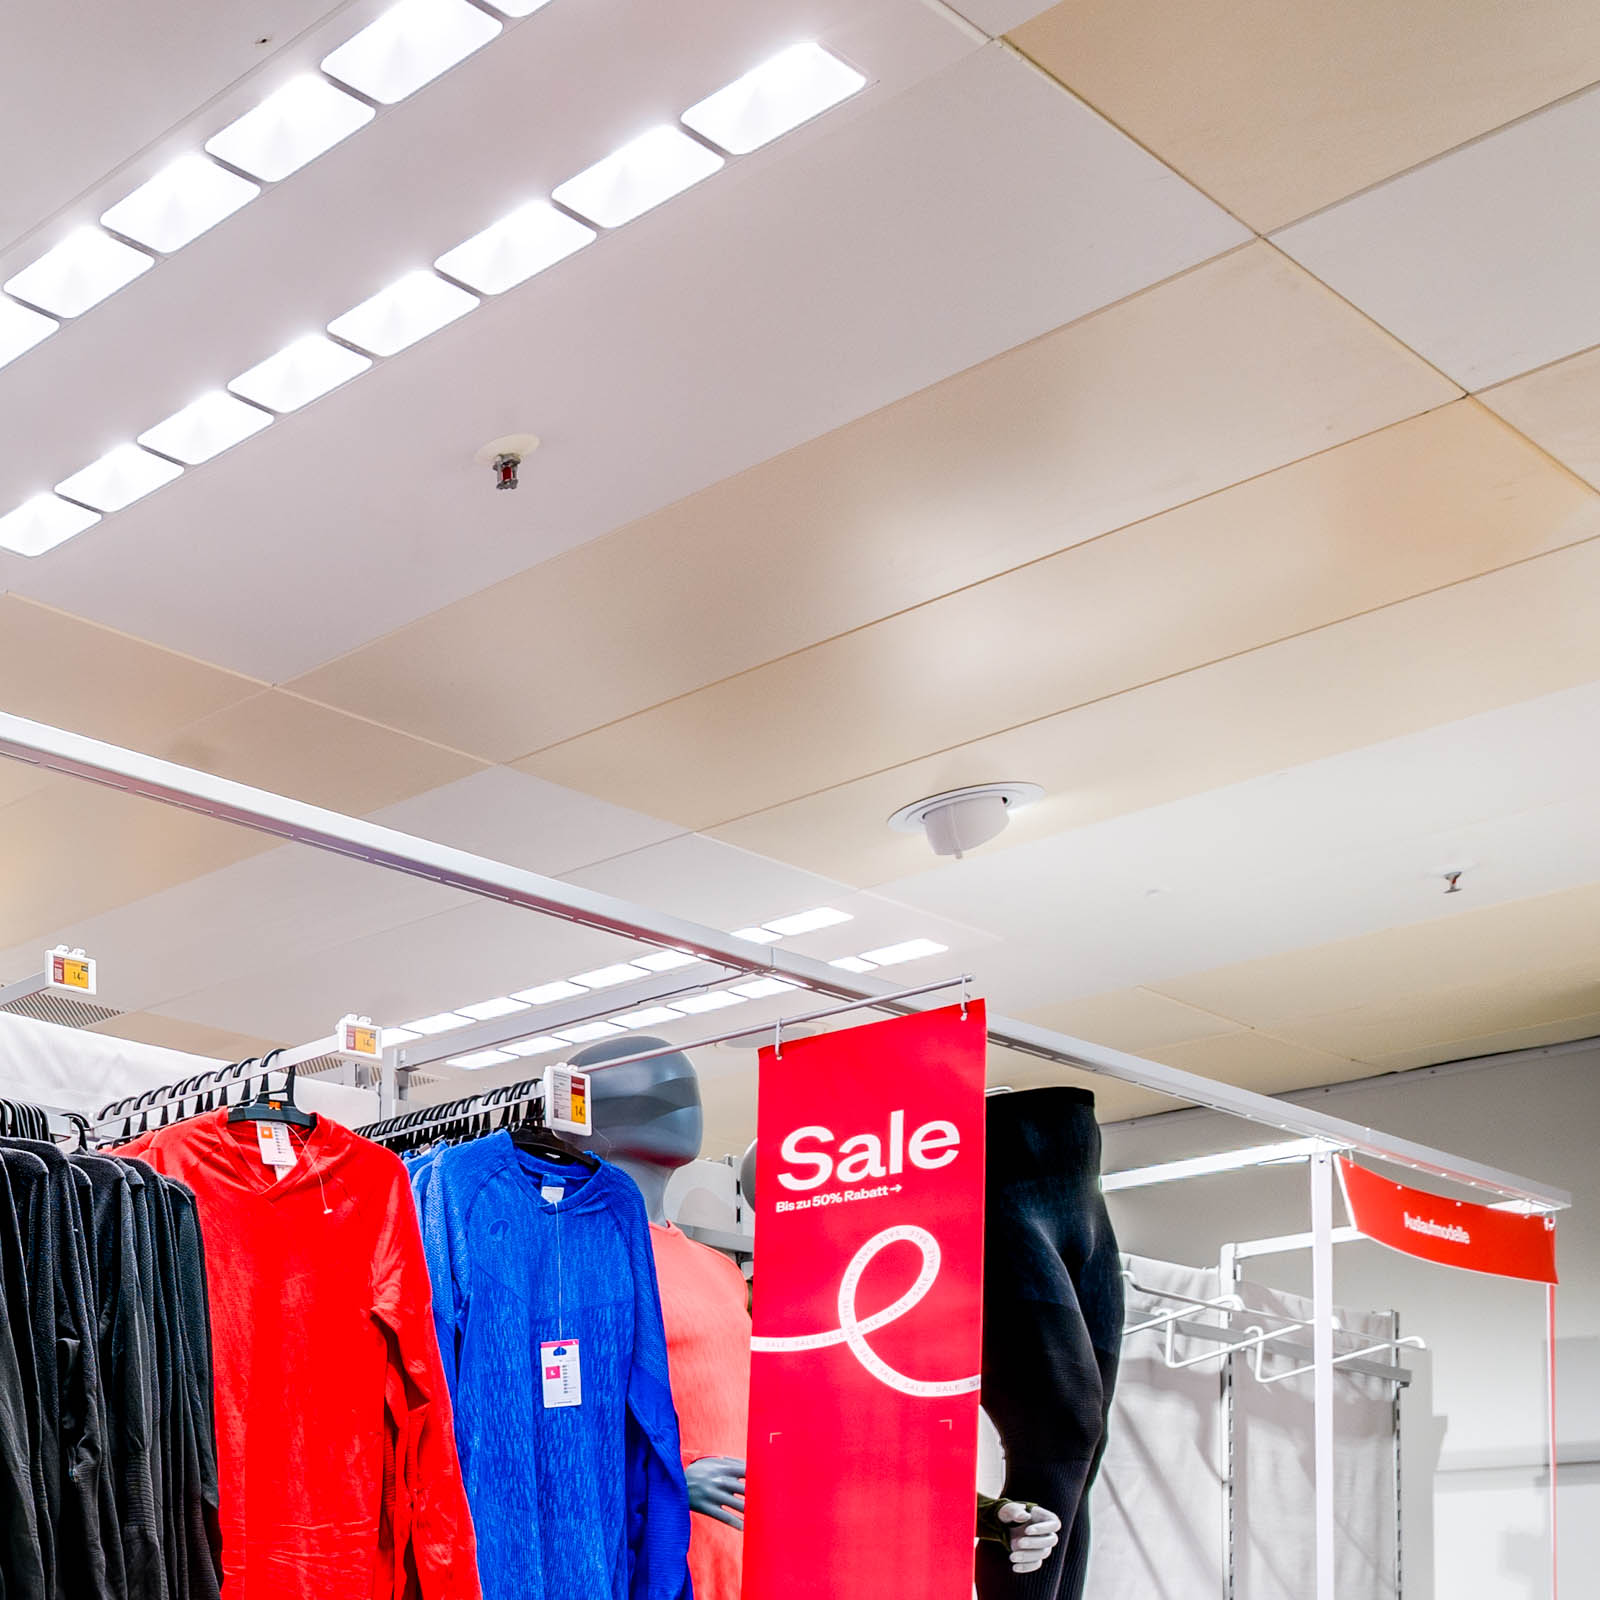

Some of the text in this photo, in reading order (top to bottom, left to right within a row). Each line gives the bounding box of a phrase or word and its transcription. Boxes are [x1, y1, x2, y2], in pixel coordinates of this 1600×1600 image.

[777, 1109, 960, 1190] Sale
[775, 1185, 889, 1213] Bis zu 50% Rabatt
